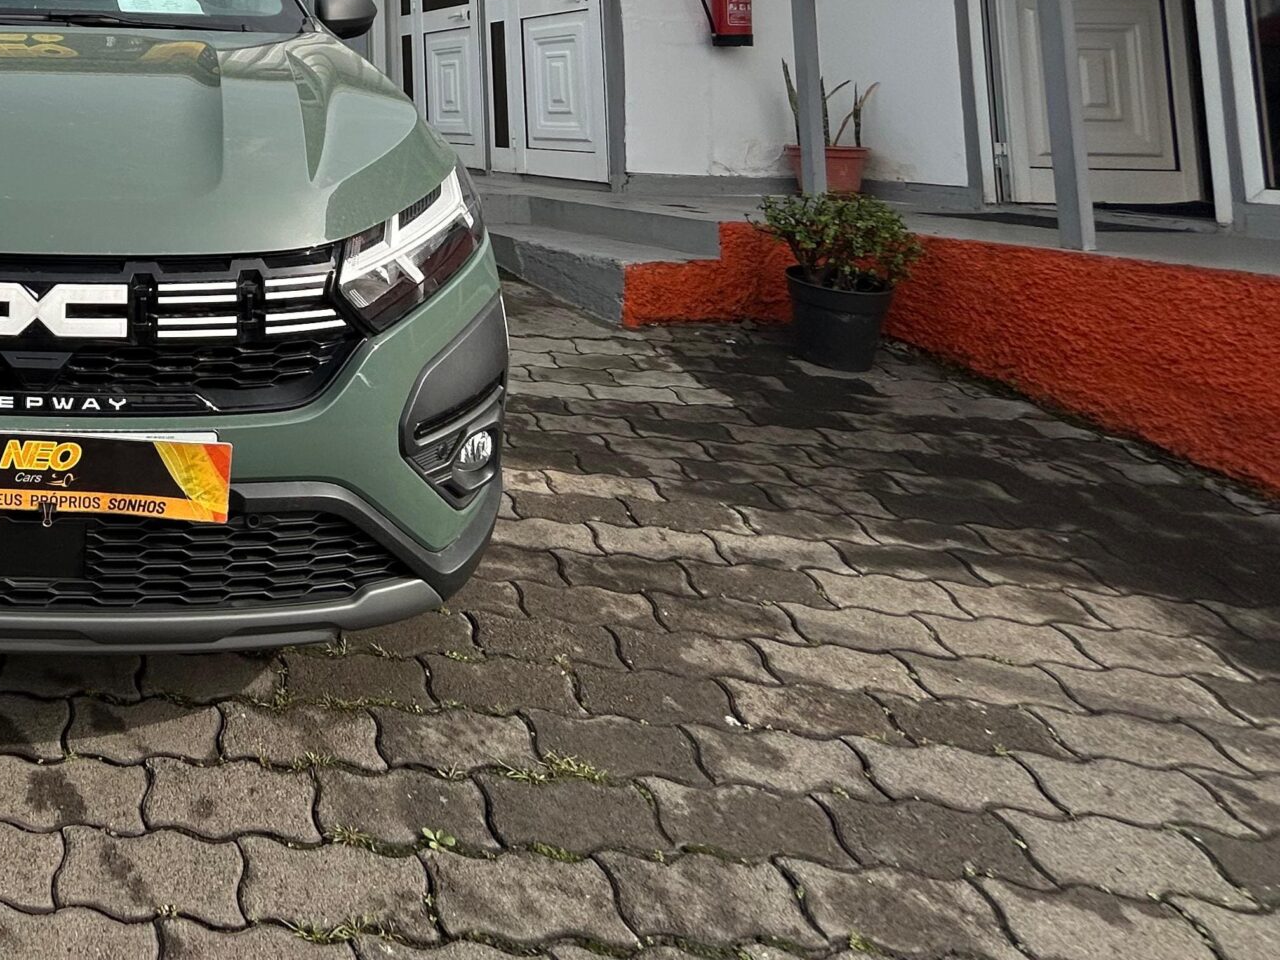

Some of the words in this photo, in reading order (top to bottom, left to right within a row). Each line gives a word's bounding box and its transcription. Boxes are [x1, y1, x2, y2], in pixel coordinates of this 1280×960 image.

[0, 440, 82, 471] NEO
[15, 471, 43, 483] Cars
[108, 498, 167, 514] SONHOS
